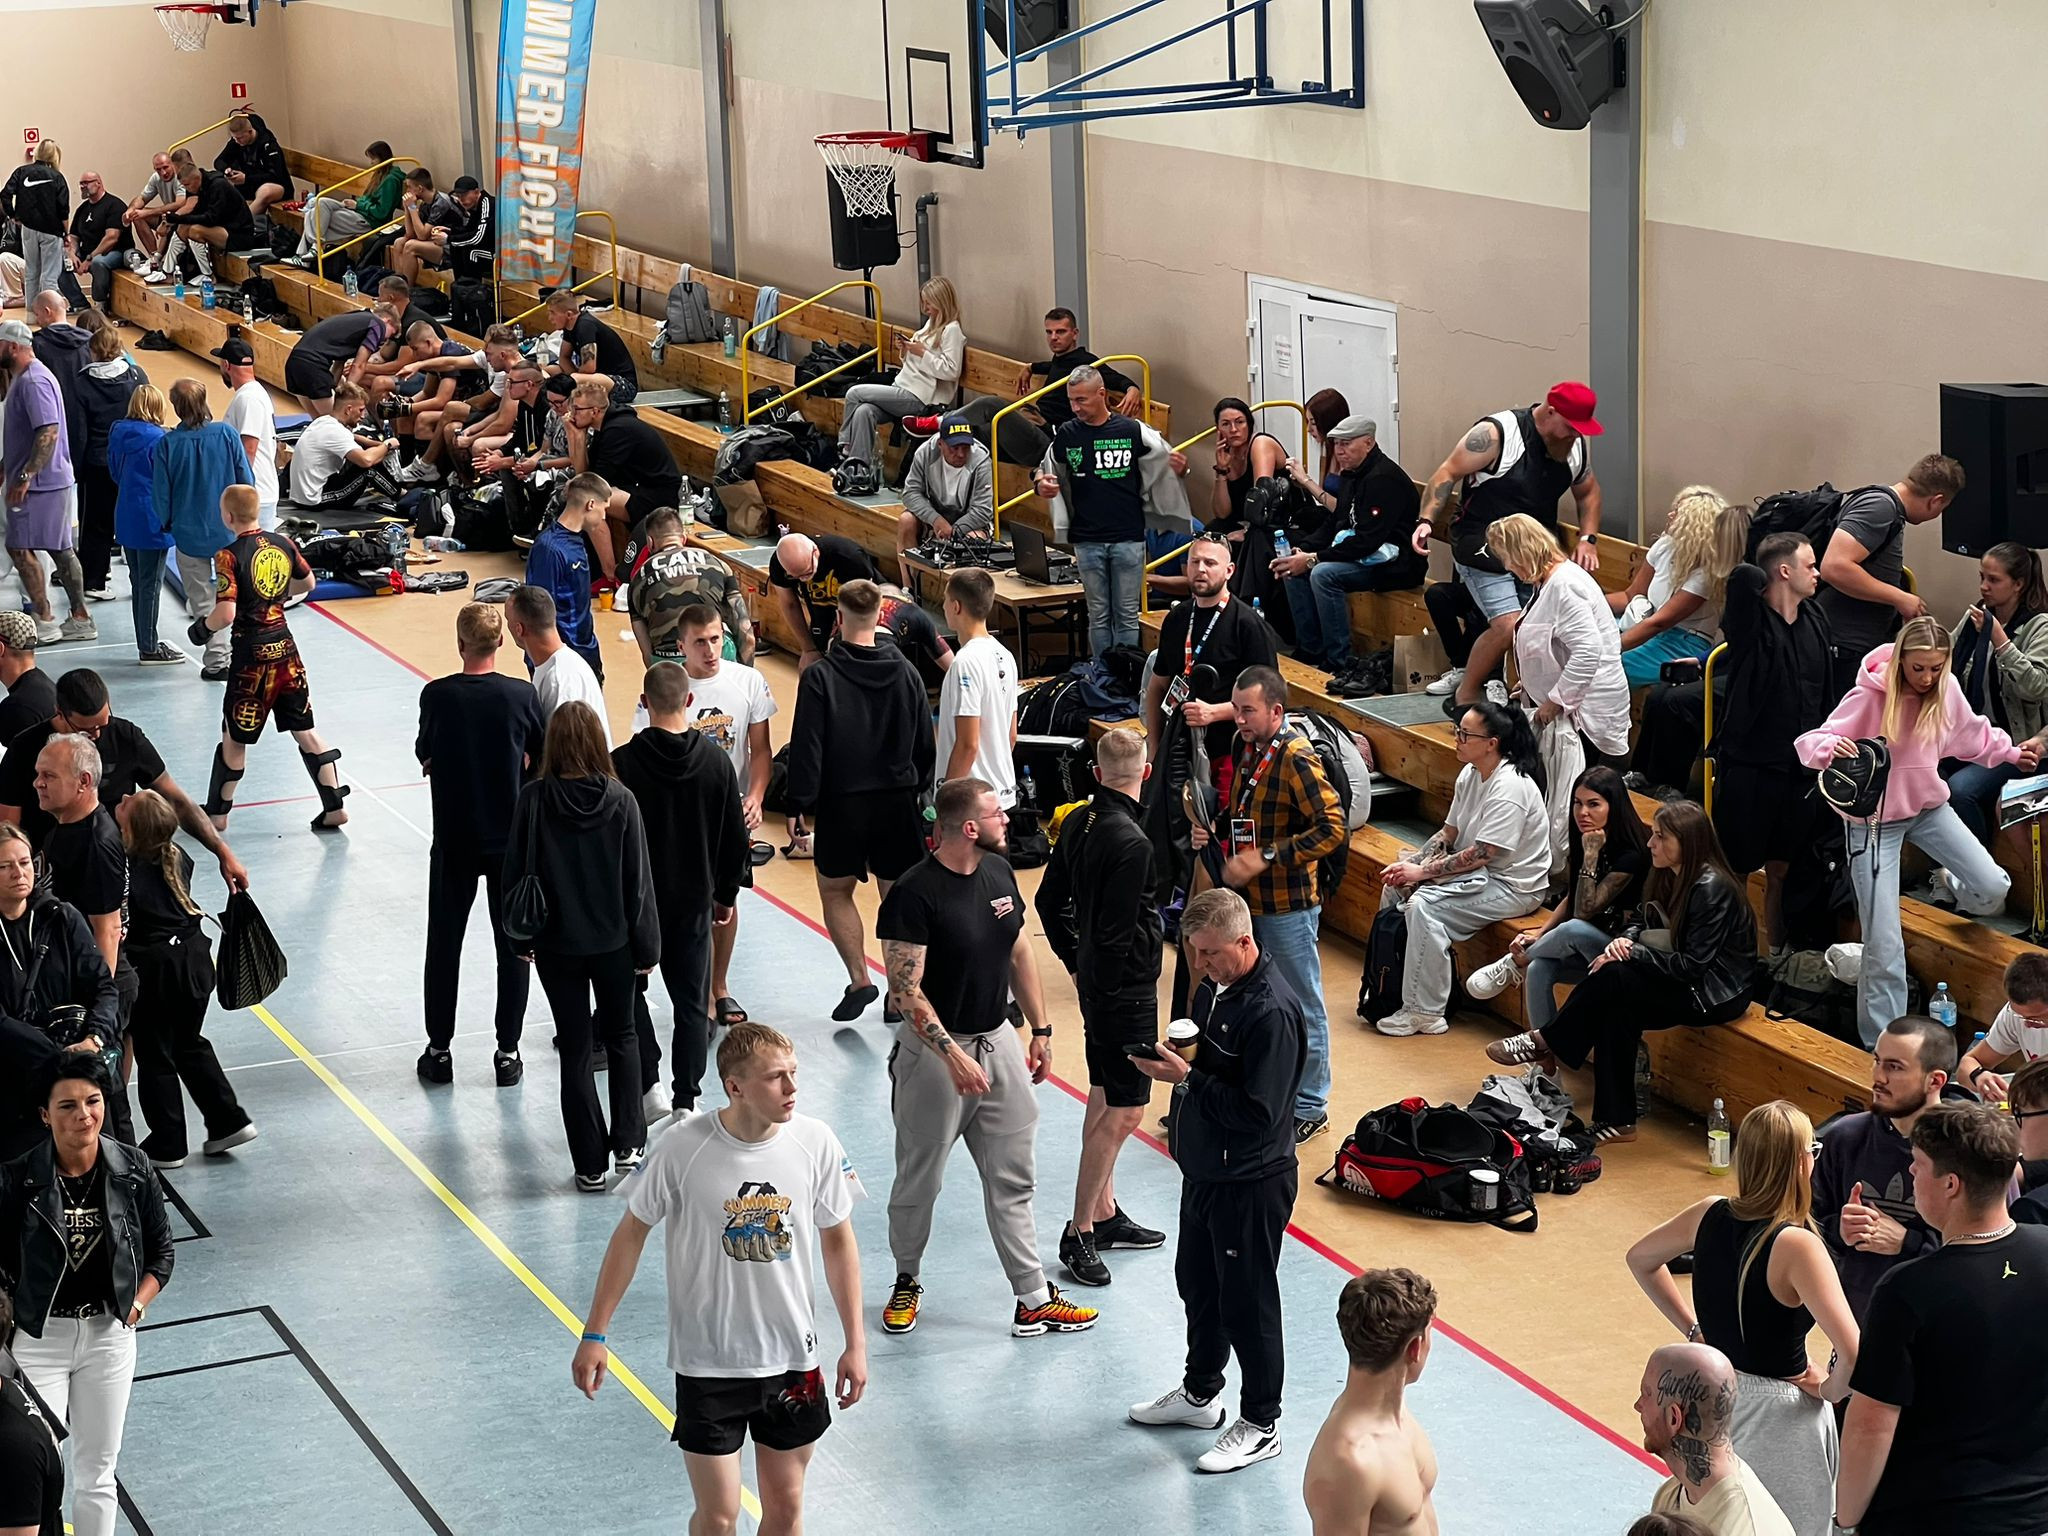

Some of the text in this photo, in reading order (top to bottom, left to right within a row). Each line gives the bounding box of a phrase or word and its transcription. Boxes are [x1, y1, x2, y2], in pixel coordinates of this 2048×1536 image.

[517, 0, 574, 263] MMER FIGHT
[1095, 449, 1132, 469] 1978
[652, 550, 706, 569] CAN
[664, 561, 702, 578] WILL
[723, 1194, 791, 1217] SUMMER
[65, 1213, 103, 1228] UESS
